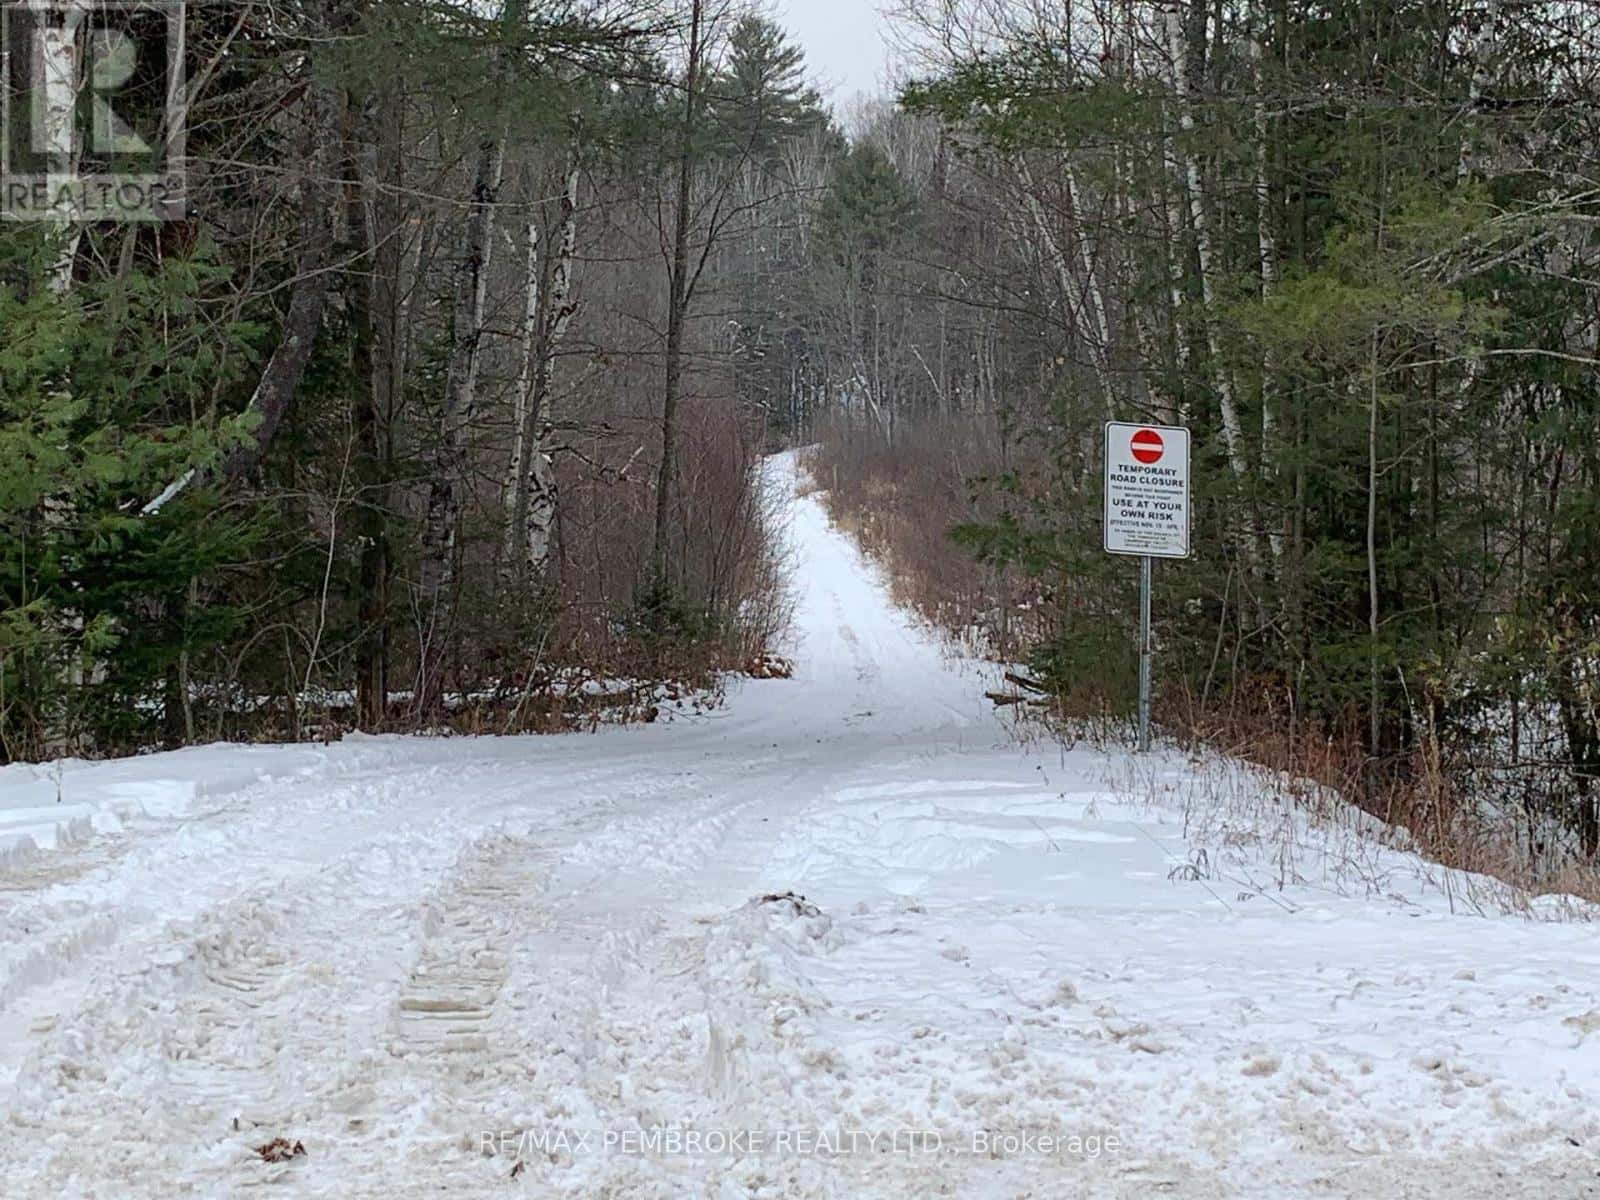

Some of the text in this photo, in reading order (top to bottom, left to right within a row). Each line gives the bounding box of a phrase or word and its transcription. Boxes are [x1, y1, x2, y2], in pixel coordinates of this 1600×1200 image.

[1118, 464, 1177, 476] TEMPORARY
[1110, 474, 1185, 487] ROAD CLOSURE
[1112, 498, 1182, 511] USE AT YOUR
[1120, 509, 1173, 521] OWN RISK
